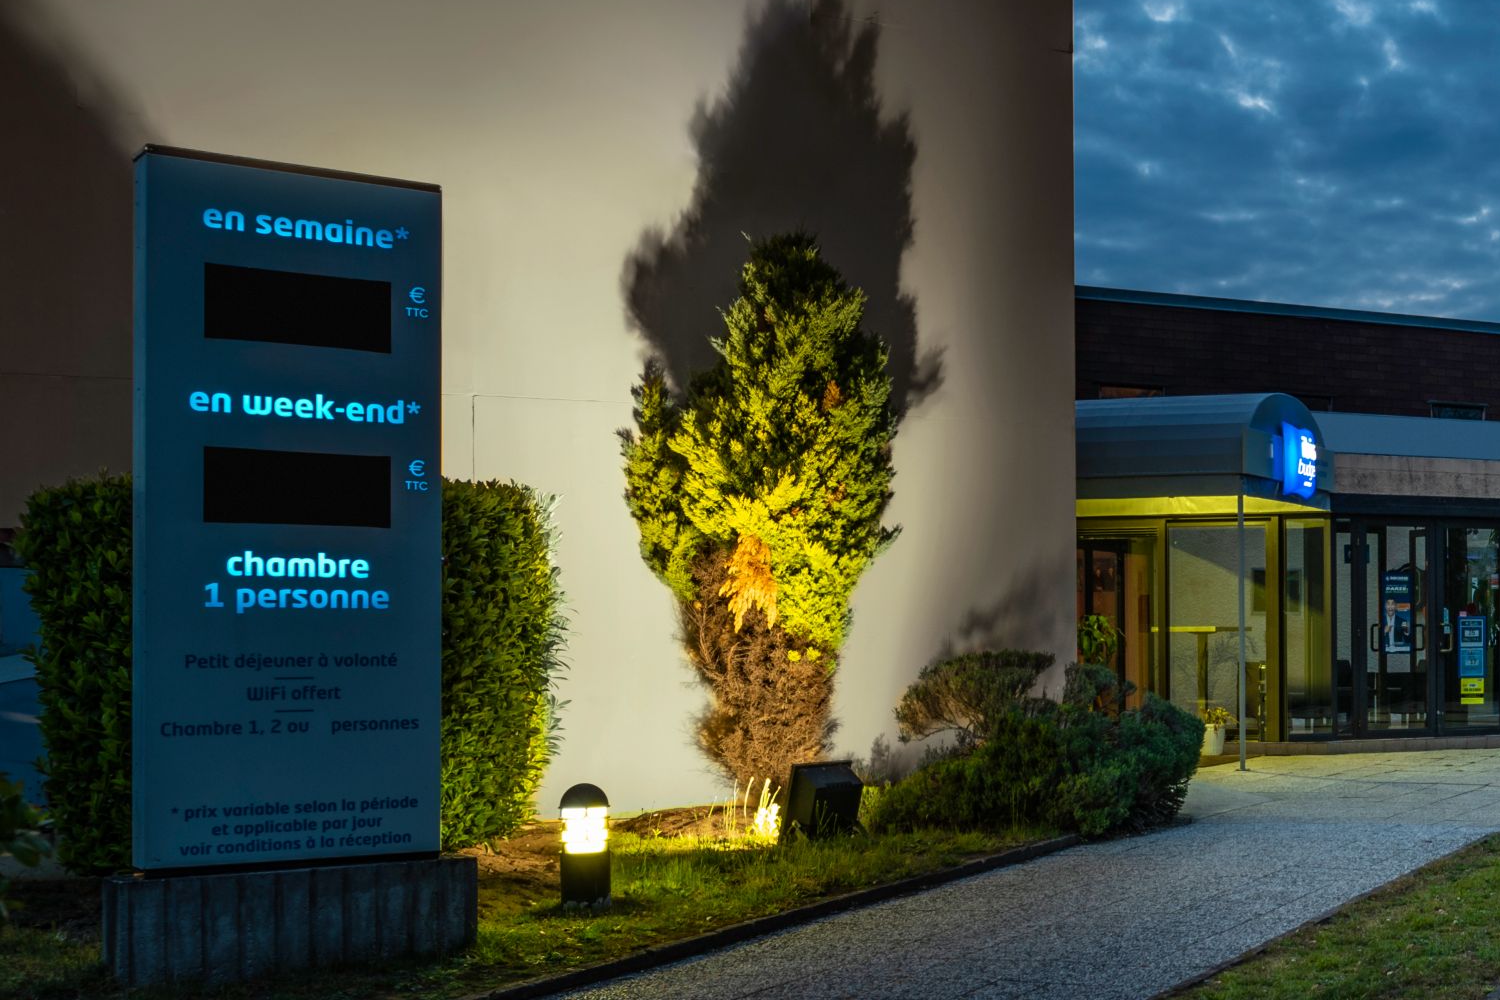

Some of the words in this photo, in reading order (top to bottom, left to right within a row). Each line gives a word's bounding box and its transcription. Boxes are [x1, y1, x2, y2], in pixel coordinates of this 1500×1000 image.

[203, 208, 244, 231] en
[409, 287, 425, 303] €
[405, 307, 428, 318] TTC
[189, 391, 231, 413] en
[408, 460, 425, 477] €
[405, 480, 428, 491] TTC
[226, 551, 370, 578] chambre
[204, 583, 224, 608] 1
[236, 586, 390, 614] personne
[185, 654, 229, 669] Petit
[234, 653, 313, 673] déjeuner
[318, 653, 329, 667] à
[334, 652, 398, 667] volonté
[246, 686, 286, 701] WiFi
[291, 686, 342, 700] offert
[160, 721, 242, 737] Chambre
[249, 720, 265, 735] 1,
[271, 719, 282, 733] 2
[287, 722, 309, 733] ou
[331, 719, 420, 735] personnes
[184, 805, 217, 822] prix
[223, 803, 290, 817] variable
[294, 800, 337, 814] selon
[342, 799, 356, 811] la
[360, 796, 419, 814] période
[212, 823, 228, 836] et
[234, 819, 317, 839] applicable
[322, 819, 347, 833] par
[351, 817, 383, 831] jour
[180, 843, 210, 857] voir
[216, 838, 301, 854] conditions
[306, 836, 315, 849] à
[320, 836, 334, 848] la
[340, 832, 412, 850] réception
